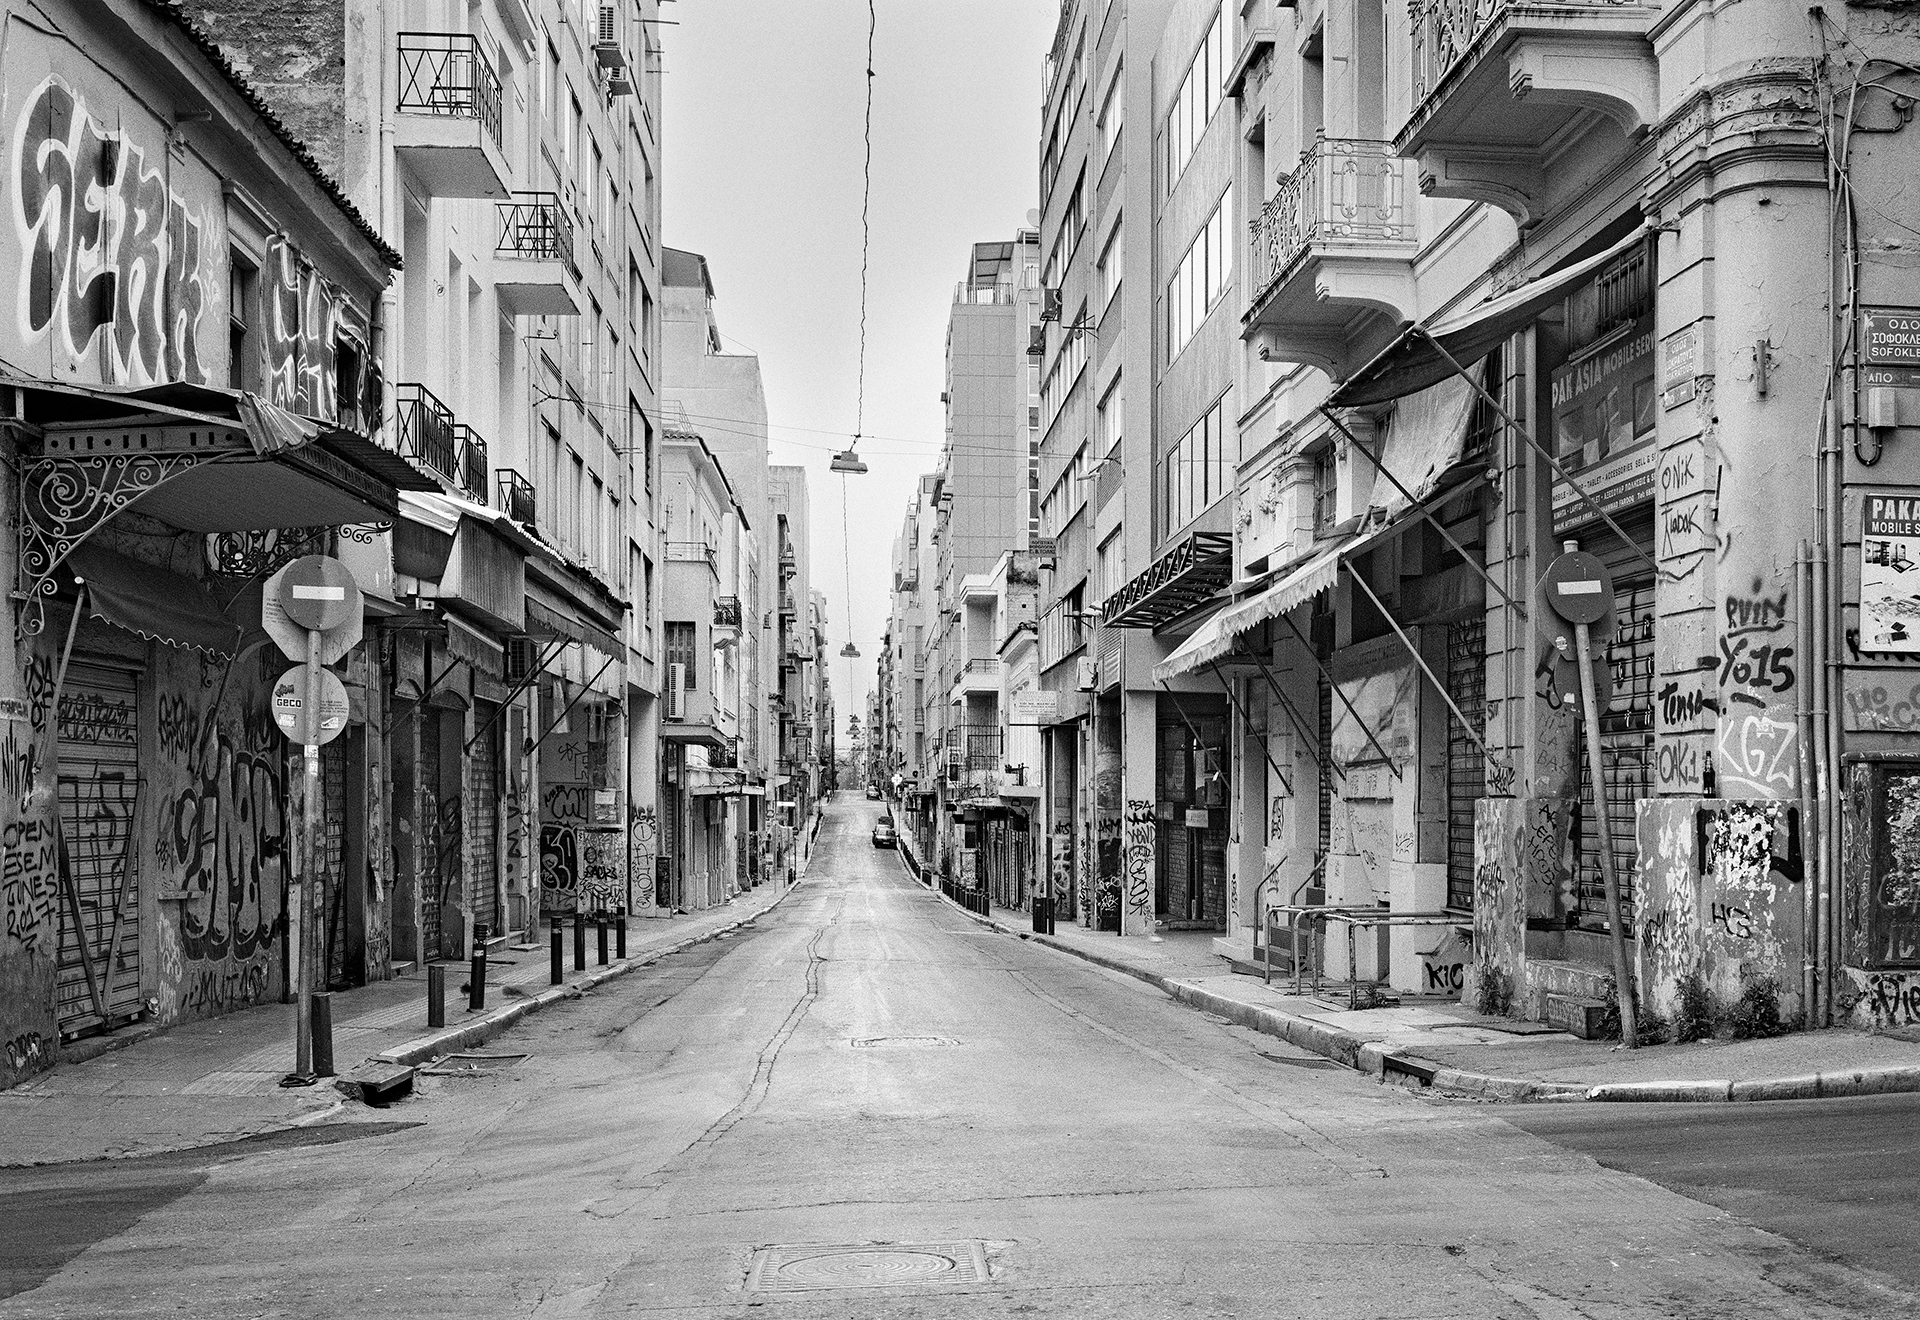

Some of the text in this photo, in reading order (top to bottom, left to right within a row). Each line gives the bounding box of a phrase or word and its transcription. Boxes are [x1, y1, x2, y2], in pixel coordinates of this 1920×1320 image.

[1552, 373, 1572, 408] PAK
[1576, 357, 1601, 396] ASIA
[1604, 342, 1634, 376] MOBILE
[1868, 372, 1893, 383] ΑΠΟ
[1872, 522, 1911, 534] MOBILE
[3, 818, 54, 850] OPEN
